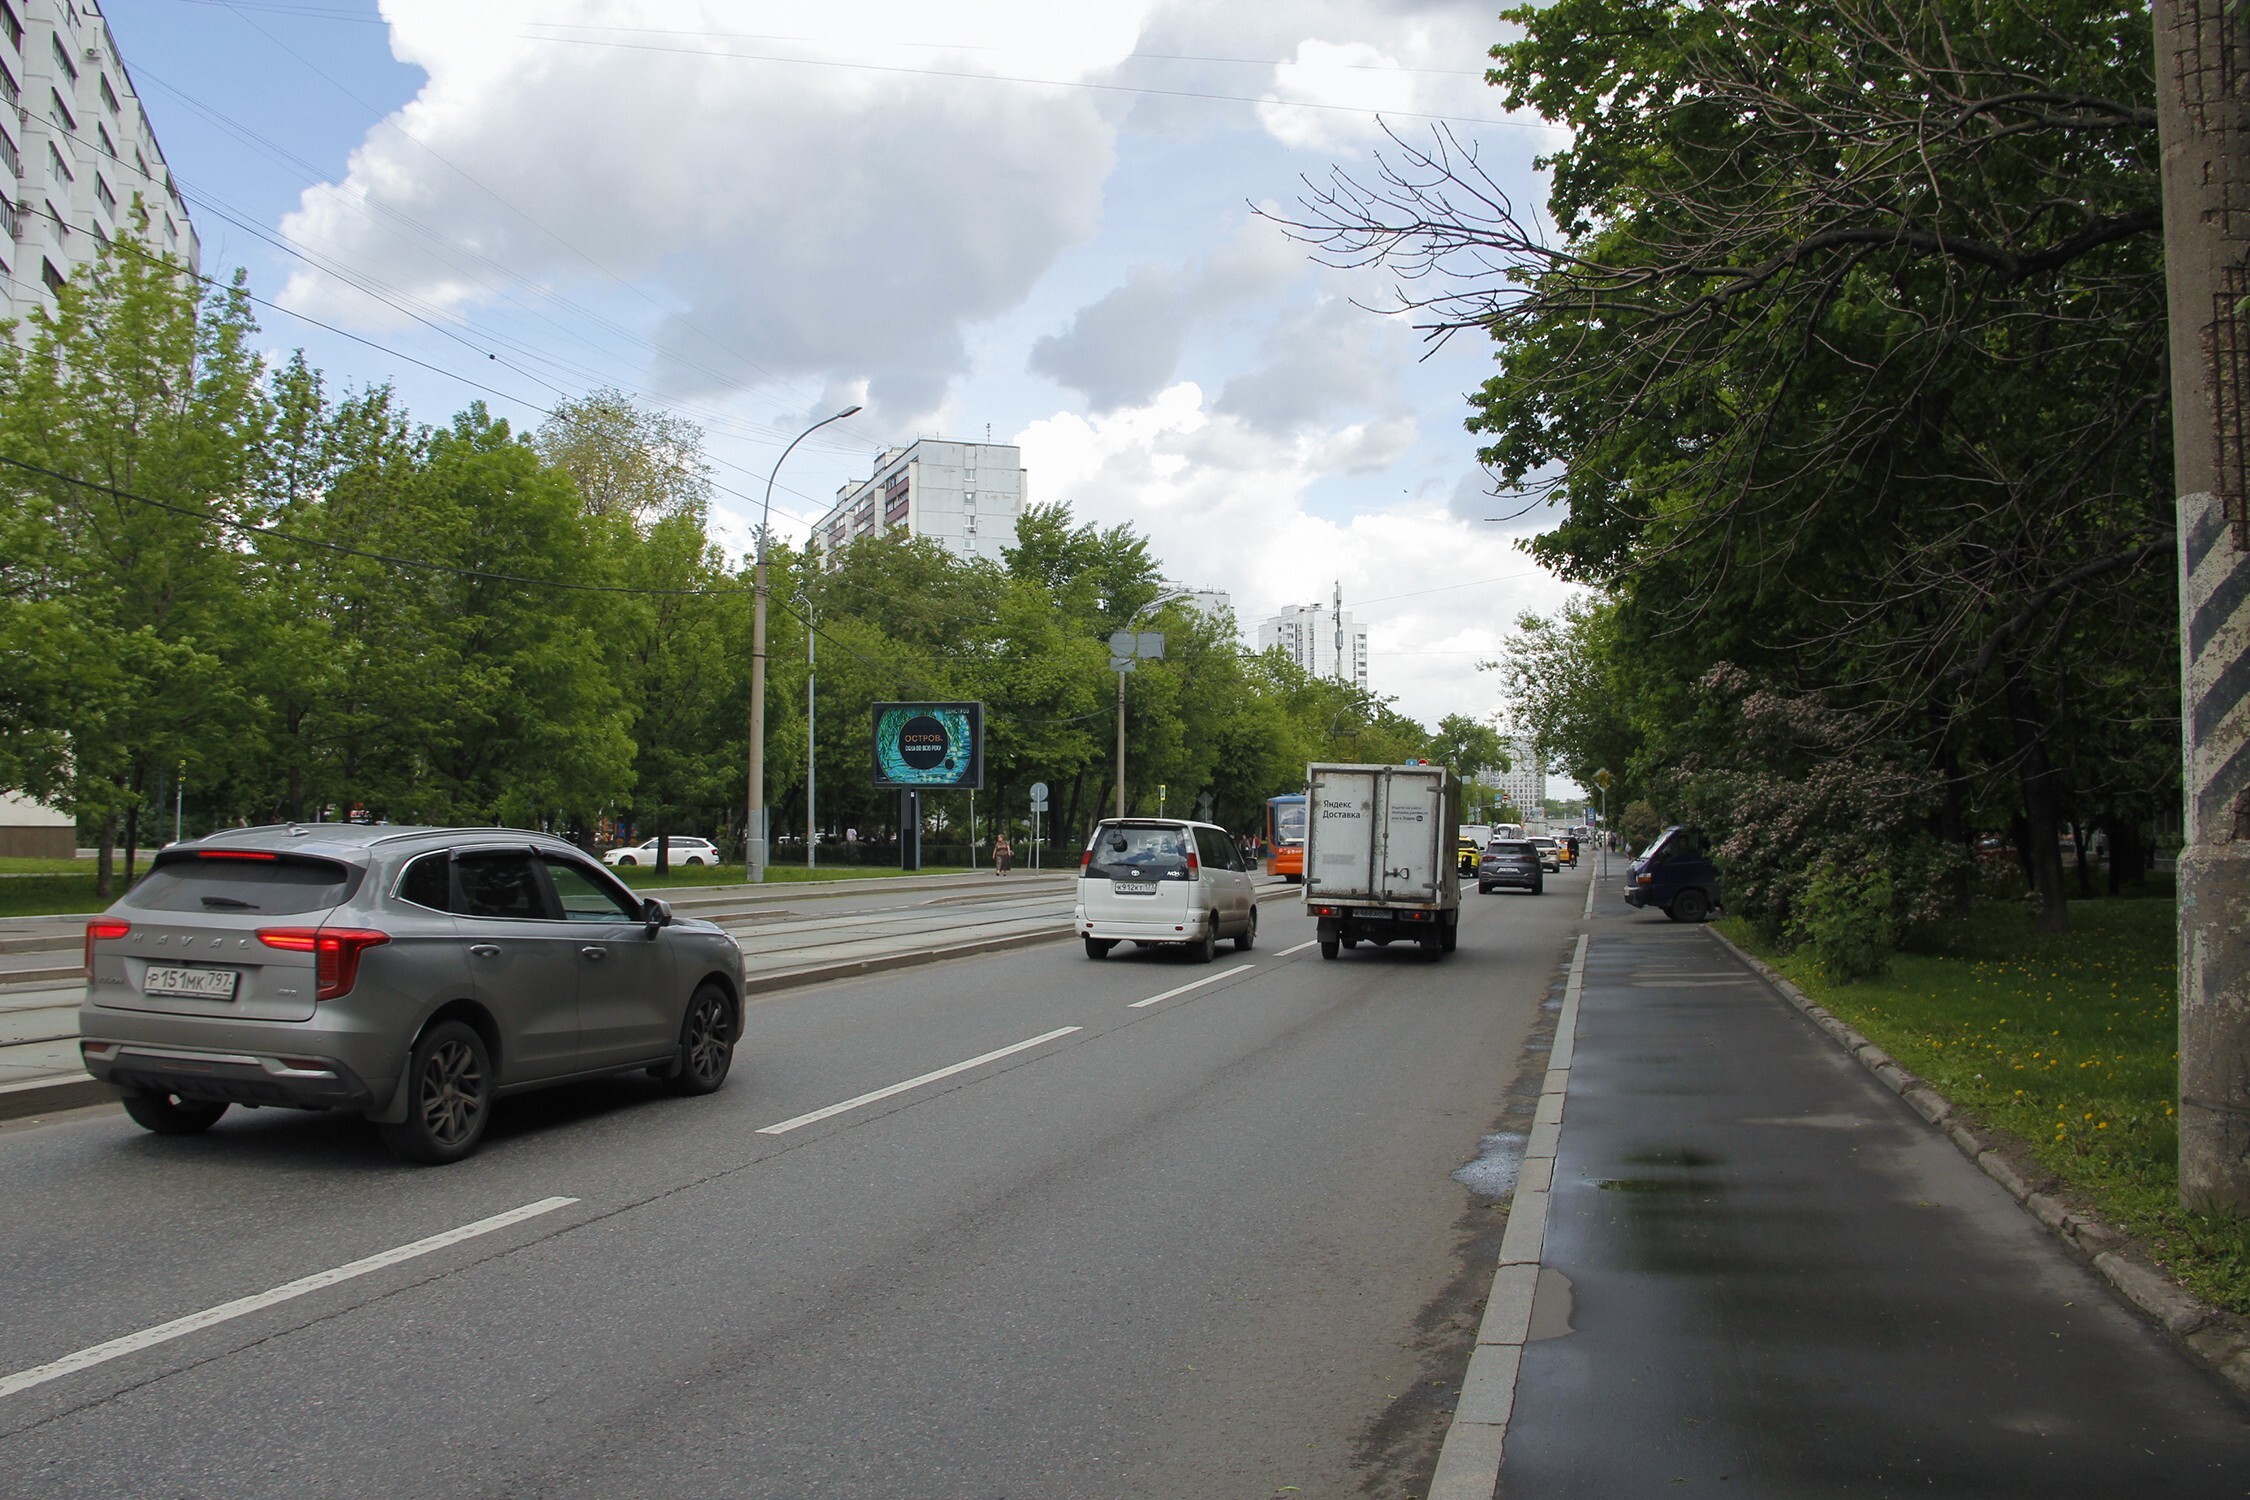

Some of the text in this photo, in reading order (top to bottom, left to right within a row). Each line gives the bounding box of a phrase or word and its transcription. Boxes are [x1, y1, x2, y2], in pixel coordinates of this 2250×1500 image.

[904, 734, 943, 742] ОСТРОВ.
[1323, 800, 1352, 809] Яндекс
[1322, 810, 1361, 819] Доставка
[132, 932, 250, 950] HAVAL
